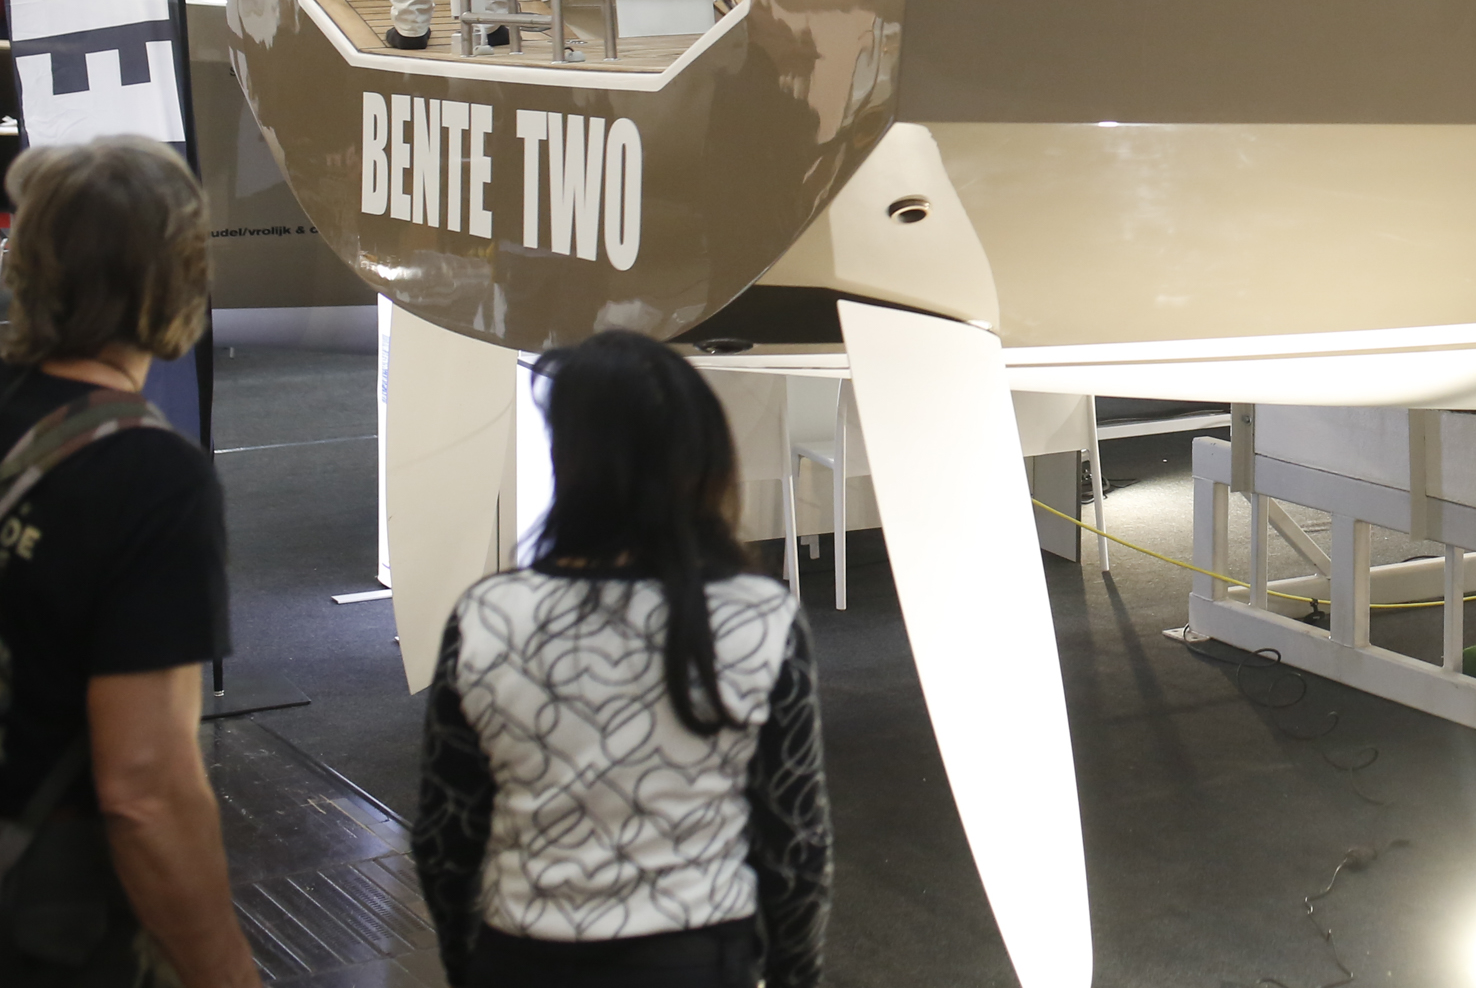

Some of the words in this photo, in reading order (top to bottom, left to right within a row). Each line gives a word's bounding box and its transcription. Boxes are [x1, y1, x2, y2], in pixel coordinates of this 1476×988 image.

[361, 91, 493, 239] BENTE
[516, 109, 643, 272] TWO
[296, 225, 305, 235] &
